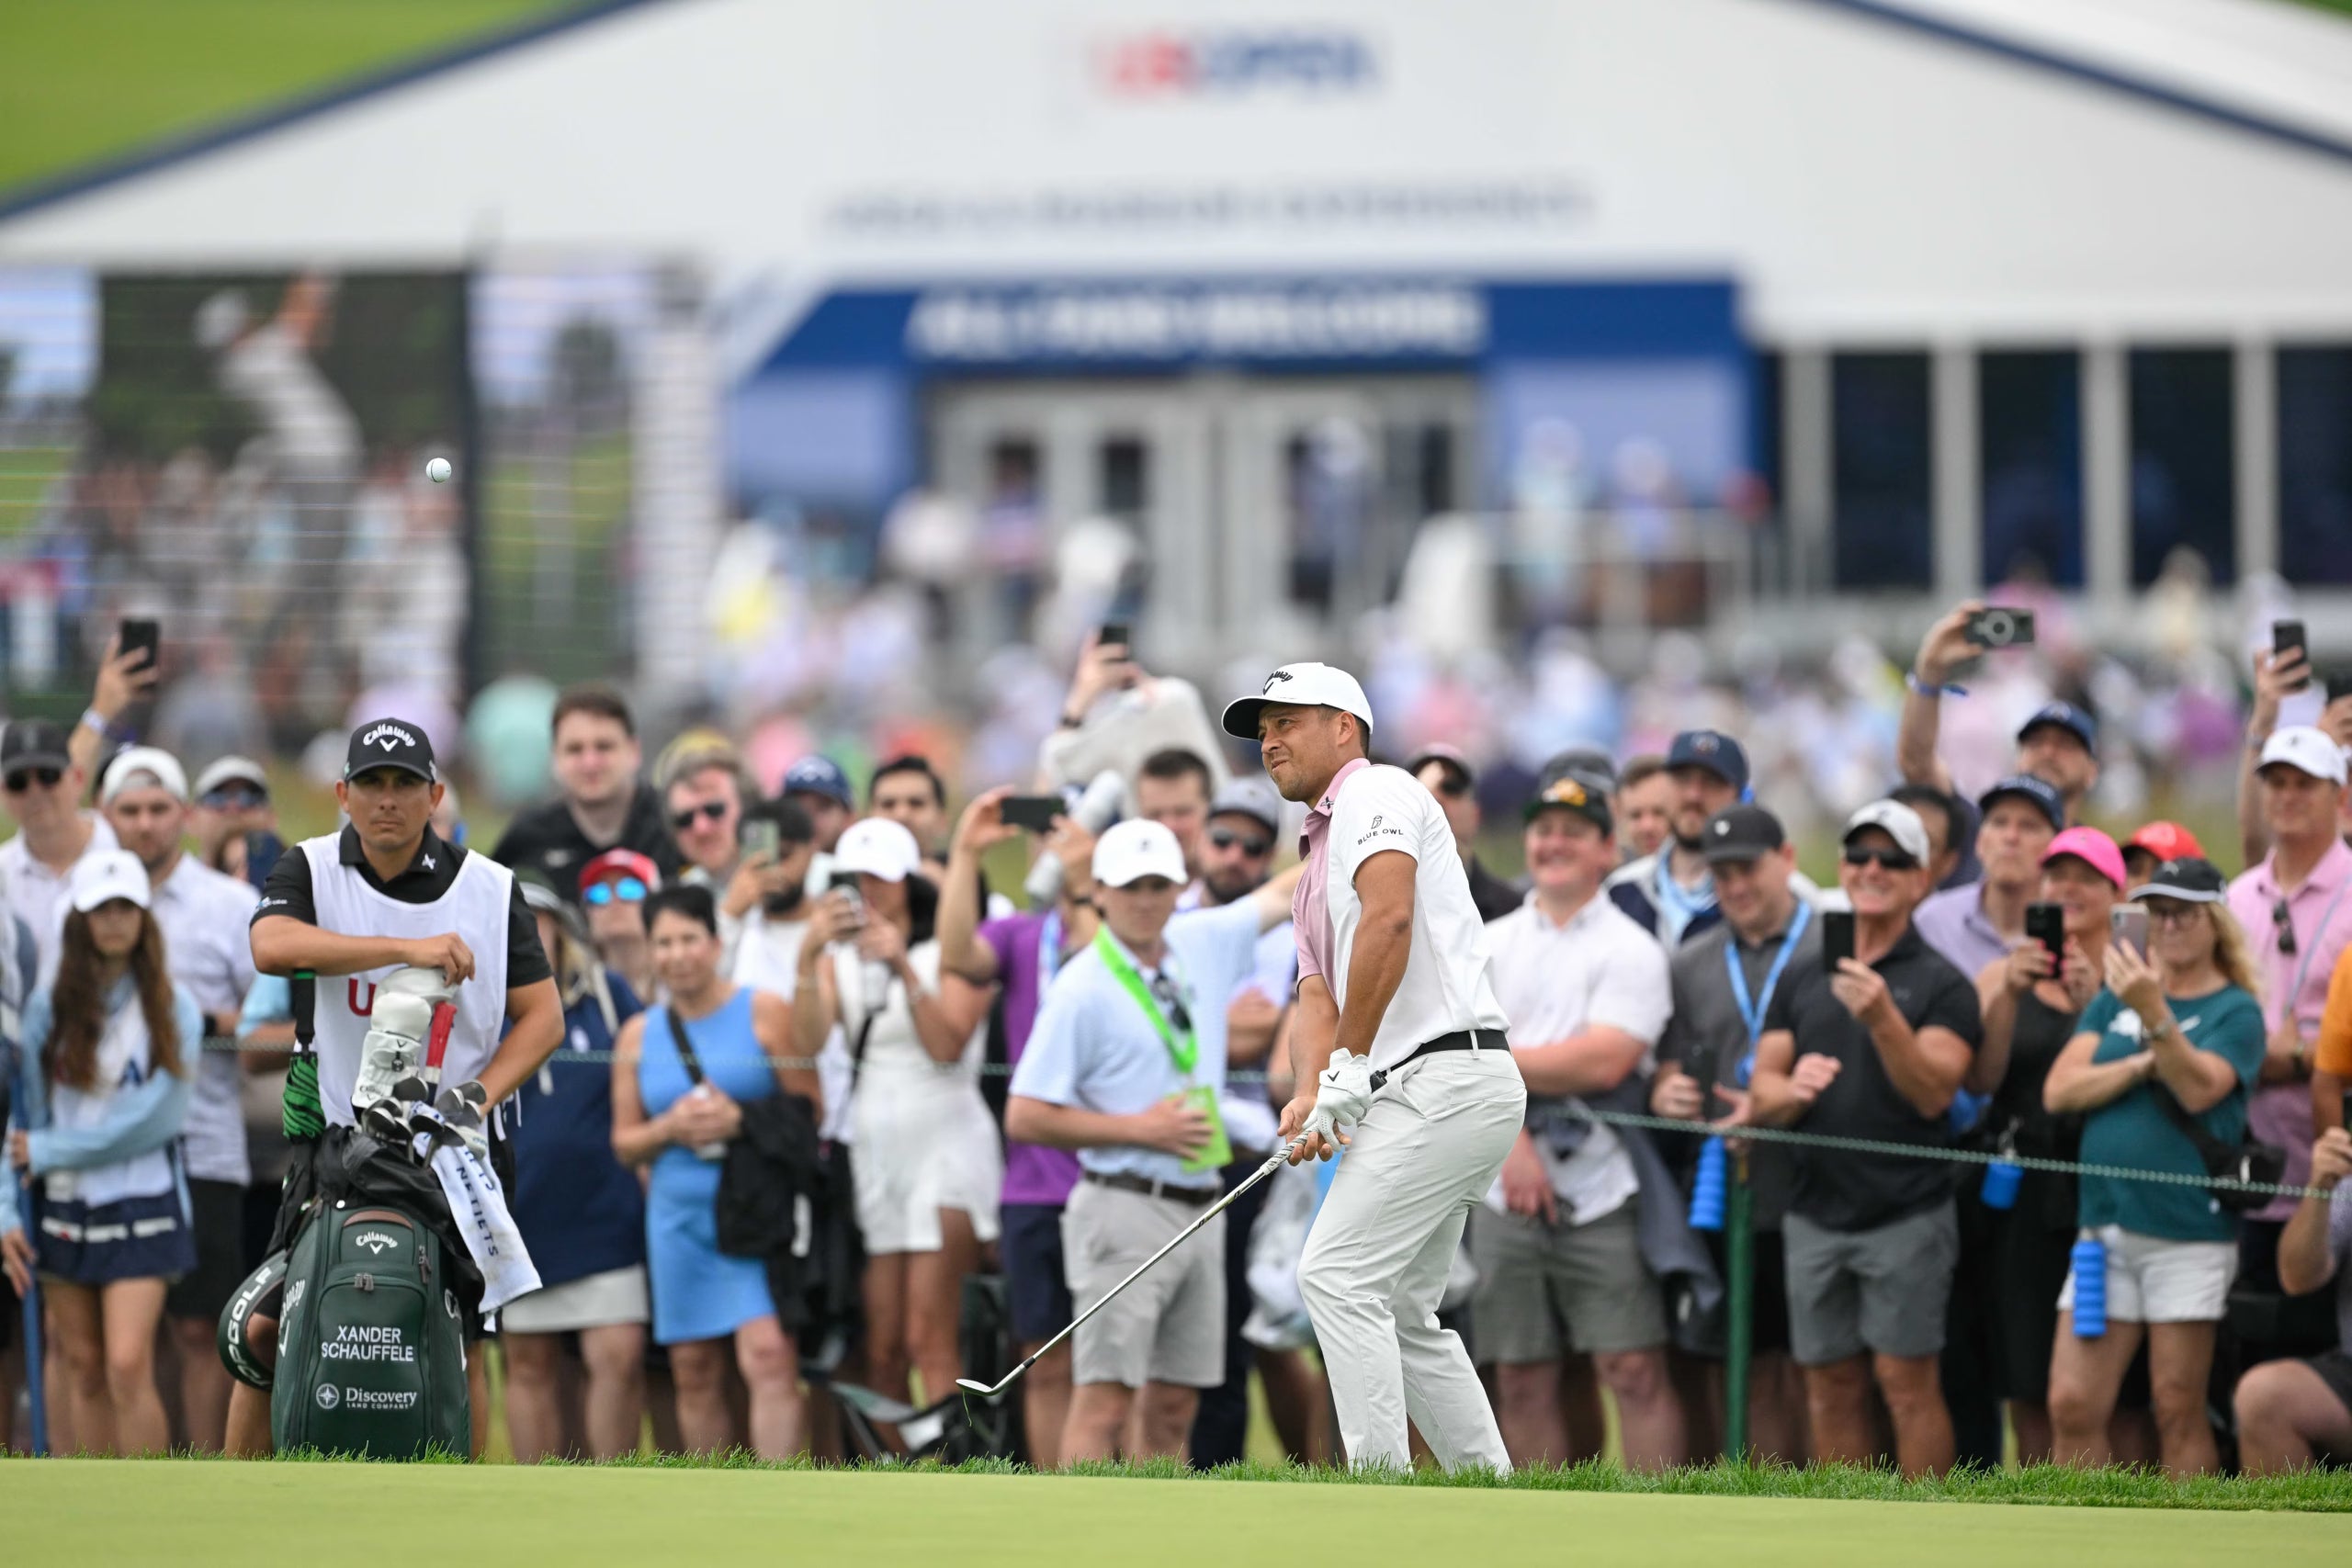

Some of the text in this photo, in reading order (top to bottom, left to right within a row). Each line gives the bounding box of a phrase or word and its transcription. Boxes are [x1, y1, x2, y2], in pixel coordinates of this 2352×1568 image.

[363, 724, 416, 747] Callaway
[1358, 830, 1379, 845] BLUE
[356, 1231, 399, 1248] Callaway
[336, 1325, 401, 1344] XANDER
[322, 1342, 414, 1362] SCHAUFFELE
[345, 1387, 417, 1406] Discovery
